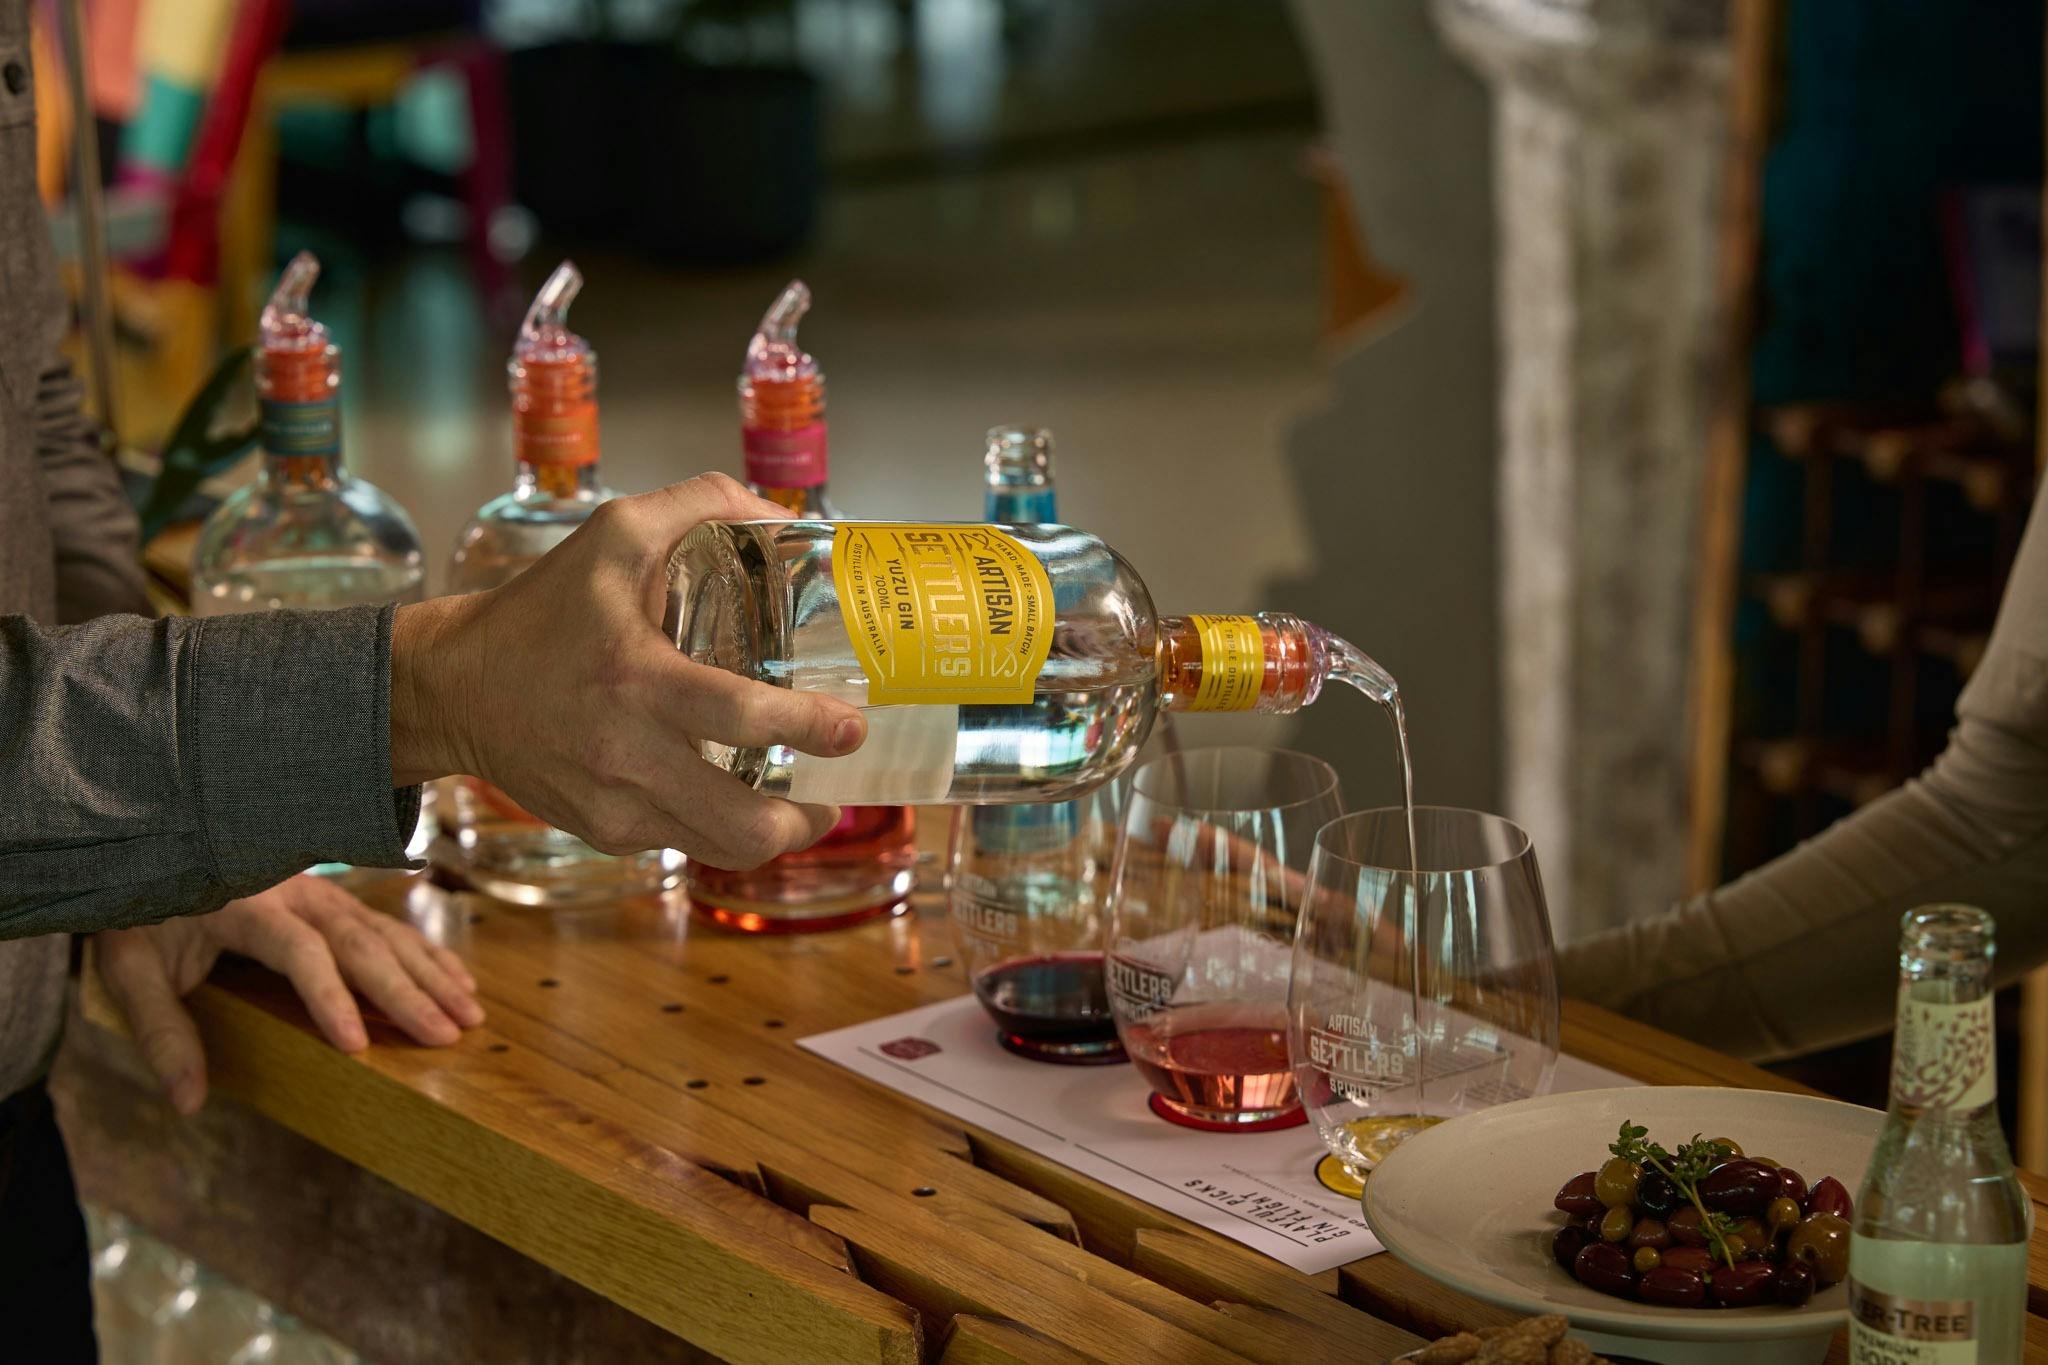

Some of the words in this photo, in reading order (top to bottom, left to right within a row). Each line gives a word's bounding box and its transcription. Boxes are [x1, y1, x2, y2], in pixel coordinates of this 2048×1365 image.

[853, 543, 863, 581] DISTILLED
[856, 585, 865, 595] IN
[873, 575, 890, 613] 700ML
[886, 559, 910, 599] YUZU
[903, 532, 971, 677] SETTLERS
[973, 555, 1013, 635] ARTISAN
[1027, 595, 1036, 625] SMALL
[859, 600, 888, 657] AUSTRALIA
[897, 602, 915, 630] GIN
[1019, 626, 1035, 655] BATCH
[1224, 629, 1237, 661] TRIPLE
[1328, 1014, 1378, 1038] ARTISAN
[1310, 1035, 1404, 1077] SETTLERS
[1329, 1078, 1380, 1101] SPIRITS
[1184, 1179, 1246, 1207] PICKS
[1240, 1192, 1313, 1223] FLIGHT
[1247, 1204, 1334, 1243] PLAYFUL
[1313, 1221, 1351, 1239] GIN
